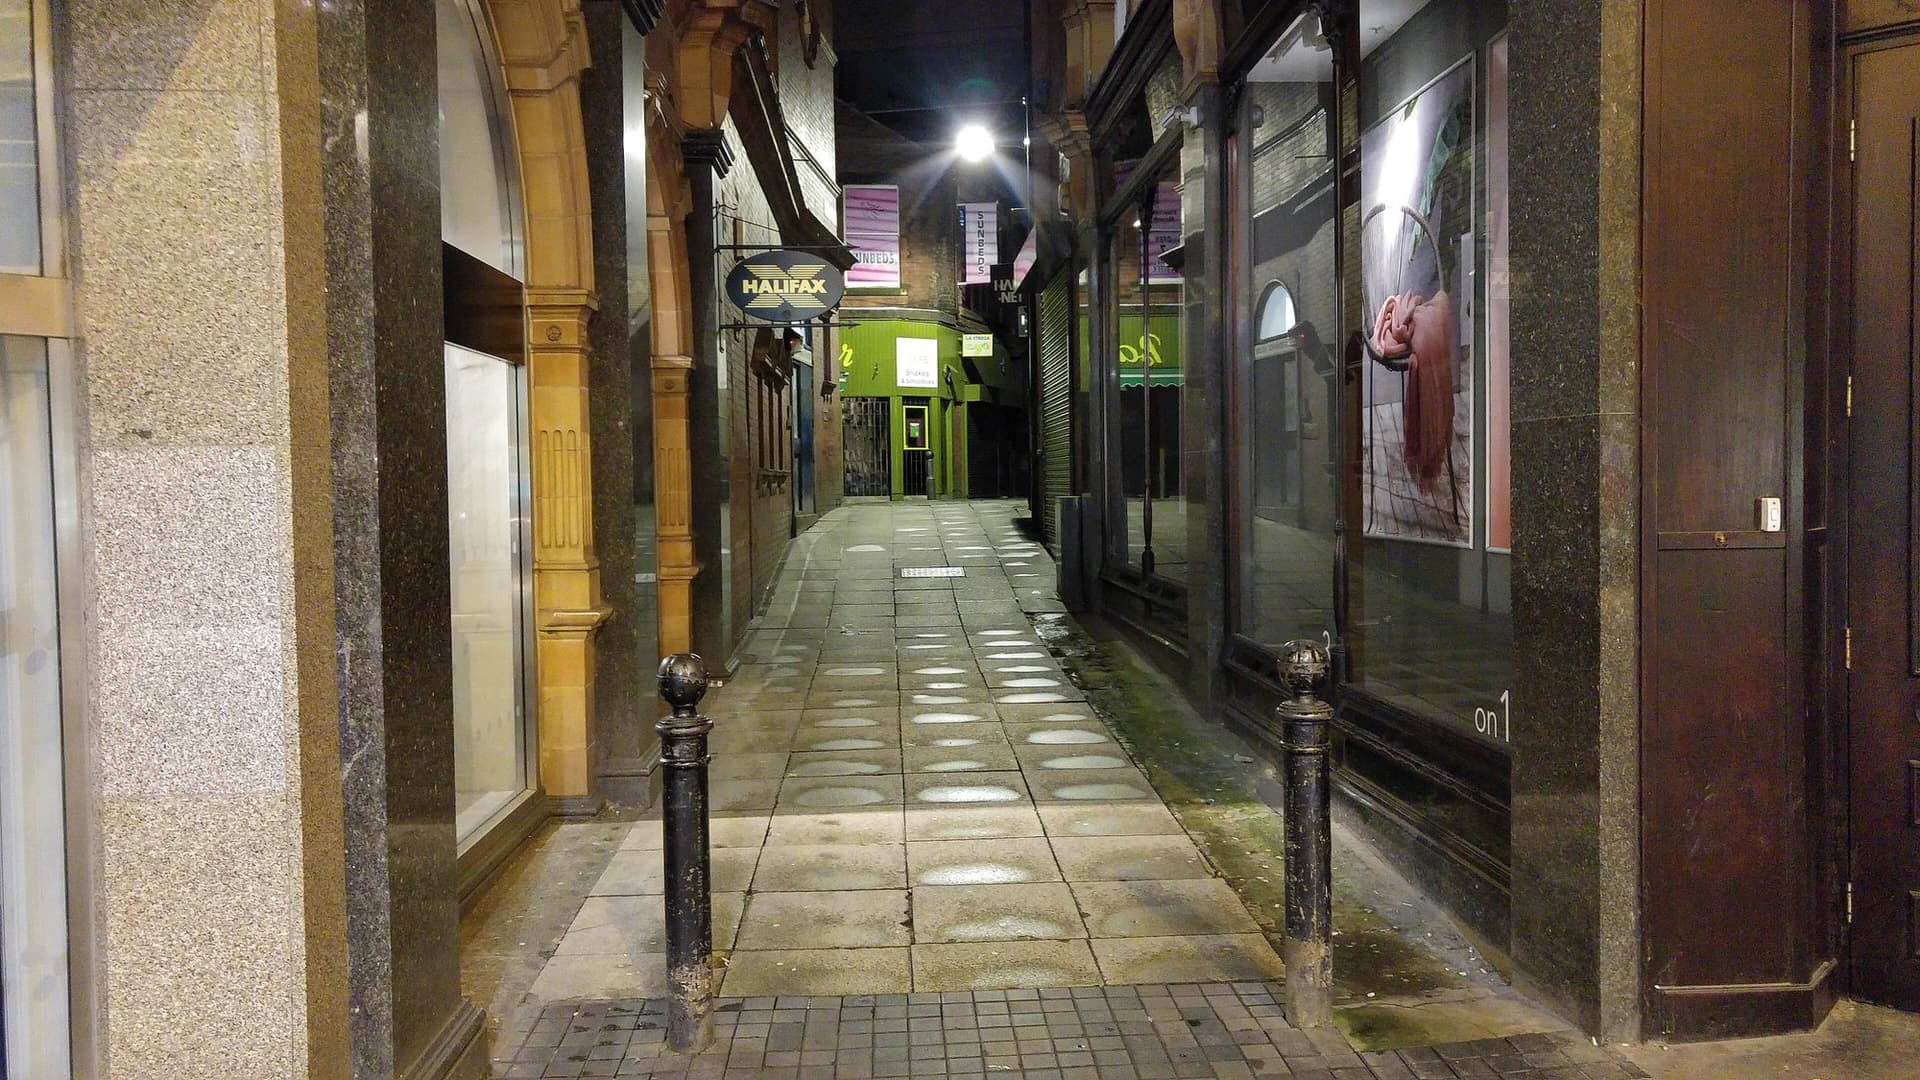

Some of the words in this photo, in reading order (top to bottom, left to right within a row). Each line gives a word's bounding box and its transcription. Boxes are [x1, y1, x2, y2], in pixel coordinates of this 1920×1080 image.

[977, 211, 985, 275] SUNBEDS
[855, 252, 895, 264] UNBEDS
[742, 279, 828, 294] HALIFAX
